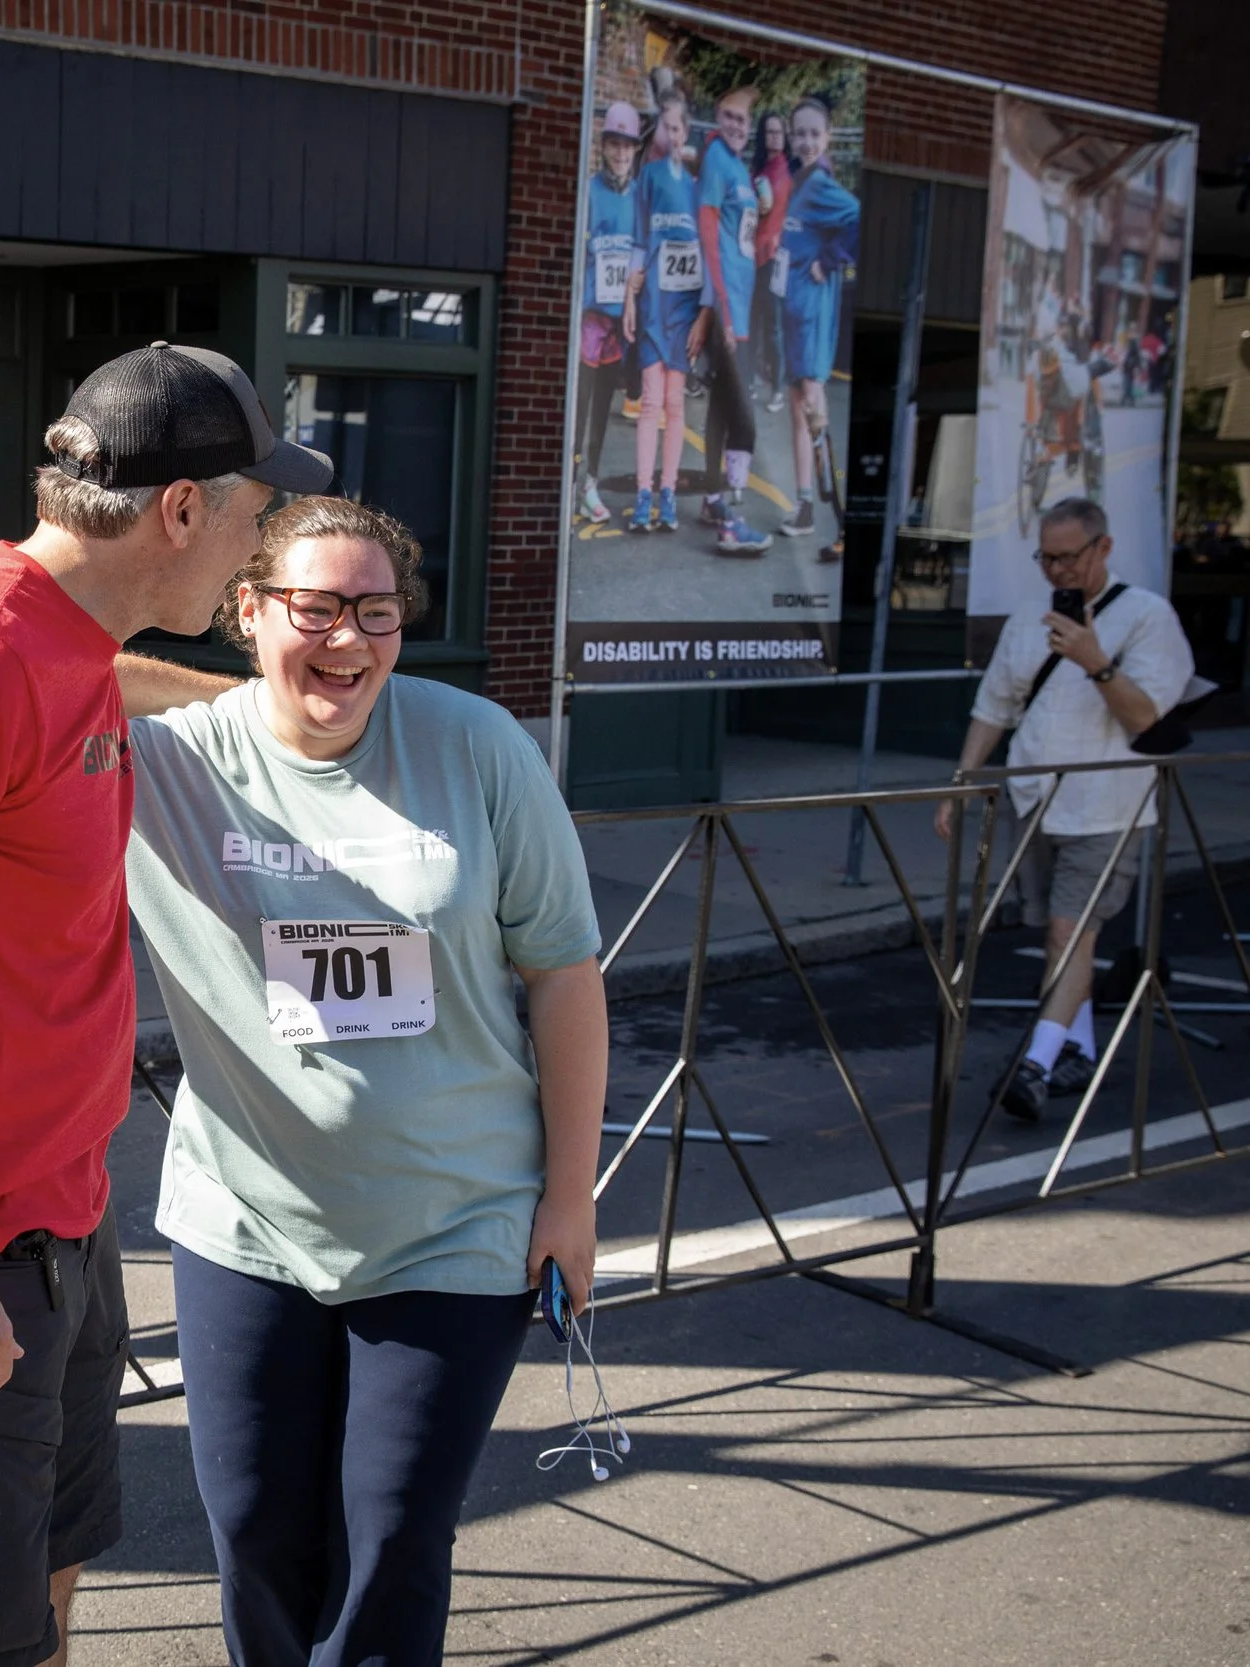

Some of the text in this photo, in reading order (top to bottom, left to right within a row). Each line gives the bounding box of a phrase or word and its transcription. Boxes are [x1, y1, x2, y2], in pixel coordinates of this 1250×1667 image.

[666, 253, 698, 276] 242
[583, 639, 823, 662] DISABILITY IS FRIENDSHIP.
[222, 830, 412, 873] BIONIC
[222, 863, 273, 876] CAMBRIDGE
[279, 924, 389, 939] BIONIC
[302, 946, 392, 1002] 701
[282, 1020, 425, 1037] FOOD DRINK DRINK
